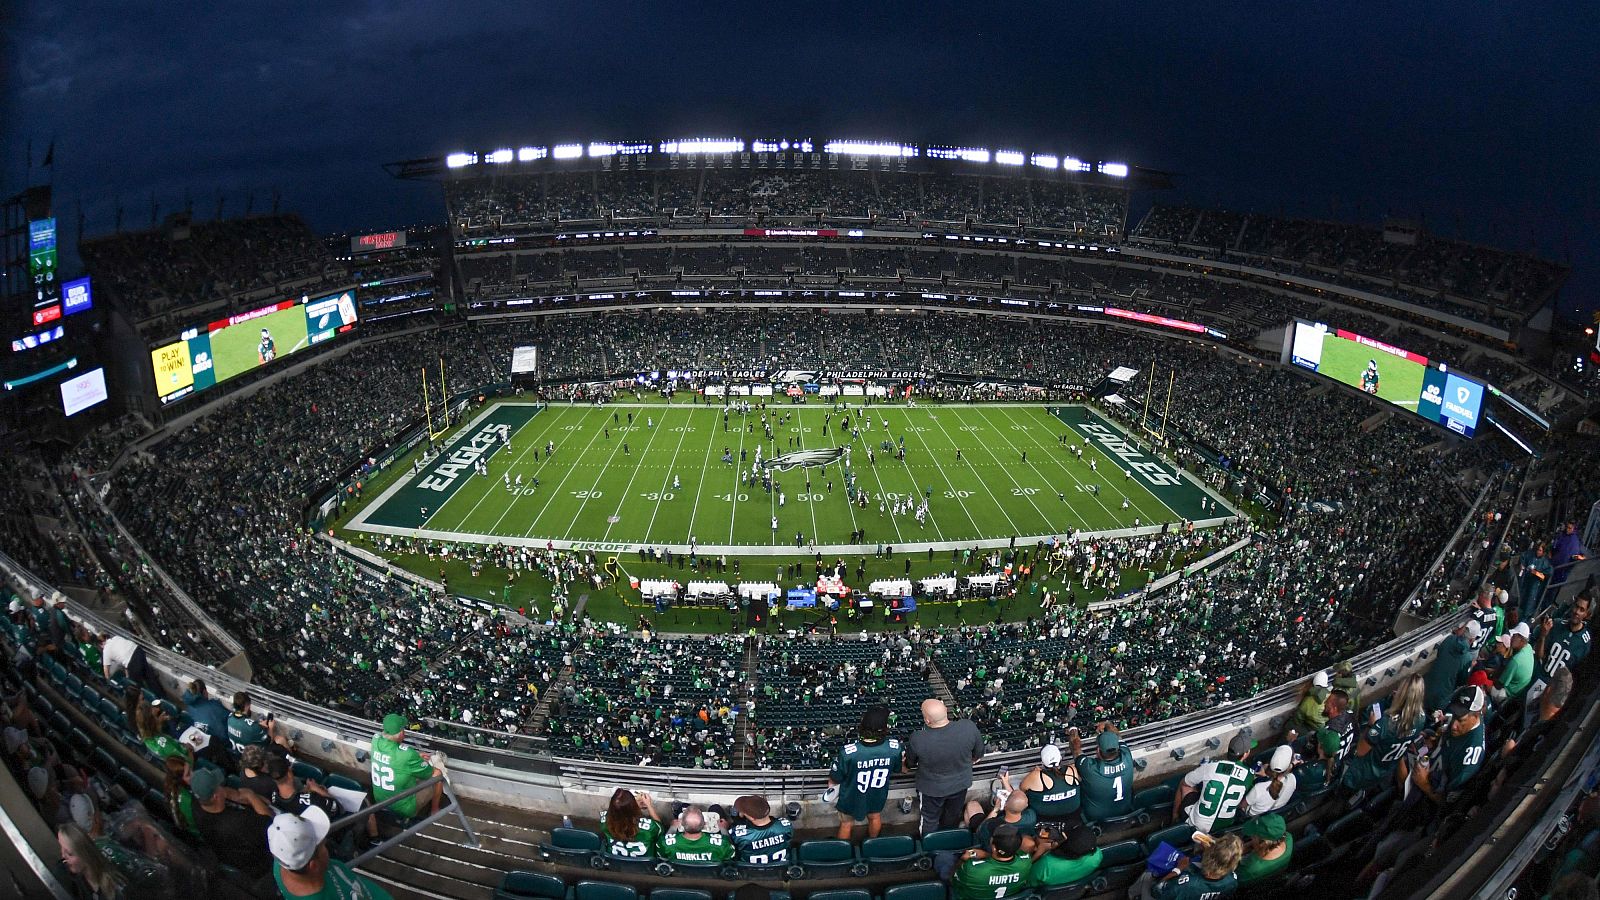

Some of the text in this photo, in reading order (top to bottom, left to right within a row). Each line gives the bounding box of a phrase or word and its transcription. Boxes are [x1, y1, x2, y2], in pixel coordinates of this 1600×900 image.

[68, 285, 85, 297] BUD
[66, 293, 88, 307] LIGHT
[234, 312, 250, 324] Lincoln
[1361, 337, 1407, 358] Lincoln Financial Field
[161, 348, 179, 362] PLAY
[167, 357, 184, 372] WIN!
[733, 370, 765, 378] EAGLES
[826, 371, 924, 379] PHILADELPHIA EAGLES
[1427, 384, 1440, 396] GO
[1445, 401, 1473, 420] FANDUEL
[416, 423, 508, 492] EAGLES
[1077, 423, 1183, 486] EAGLES
[511, 487, 535, 496] 10
[577, 490, 602, 499] 20
[944, 490, 968, 499] 30
[1010, 487, 1035, 496] 20
[1074, 484, 1097, 493] 10
[647, 492, 674, 501] 30
[721, 493, 749, 502] 40
[797, 493, 824, 502] 50
[873, 492, 897, 500] 40
[570, 542, 632, 551] KICKOFF
[1381, 740, 1411, 762] 26
[1463, 746, 1482, 765] 20
[857, 757, 891, 769] CARTER
[1104, 763, 1126, 775] HURTS
[371, 762, 394, 791] 62
[857, 768, 889, 794] 98
[1043, 788, 1077, 802] EAGLES
[1112, 776, 1124, 802] 1
[1199, 779, 1246, 819] 92
[752, 834, 785, 850] KEARSE
[676, 852, 712, 861] BARKLEY
[989, 873, 1020, 885] HURTS
[994, 886, 1007, 899] 1
